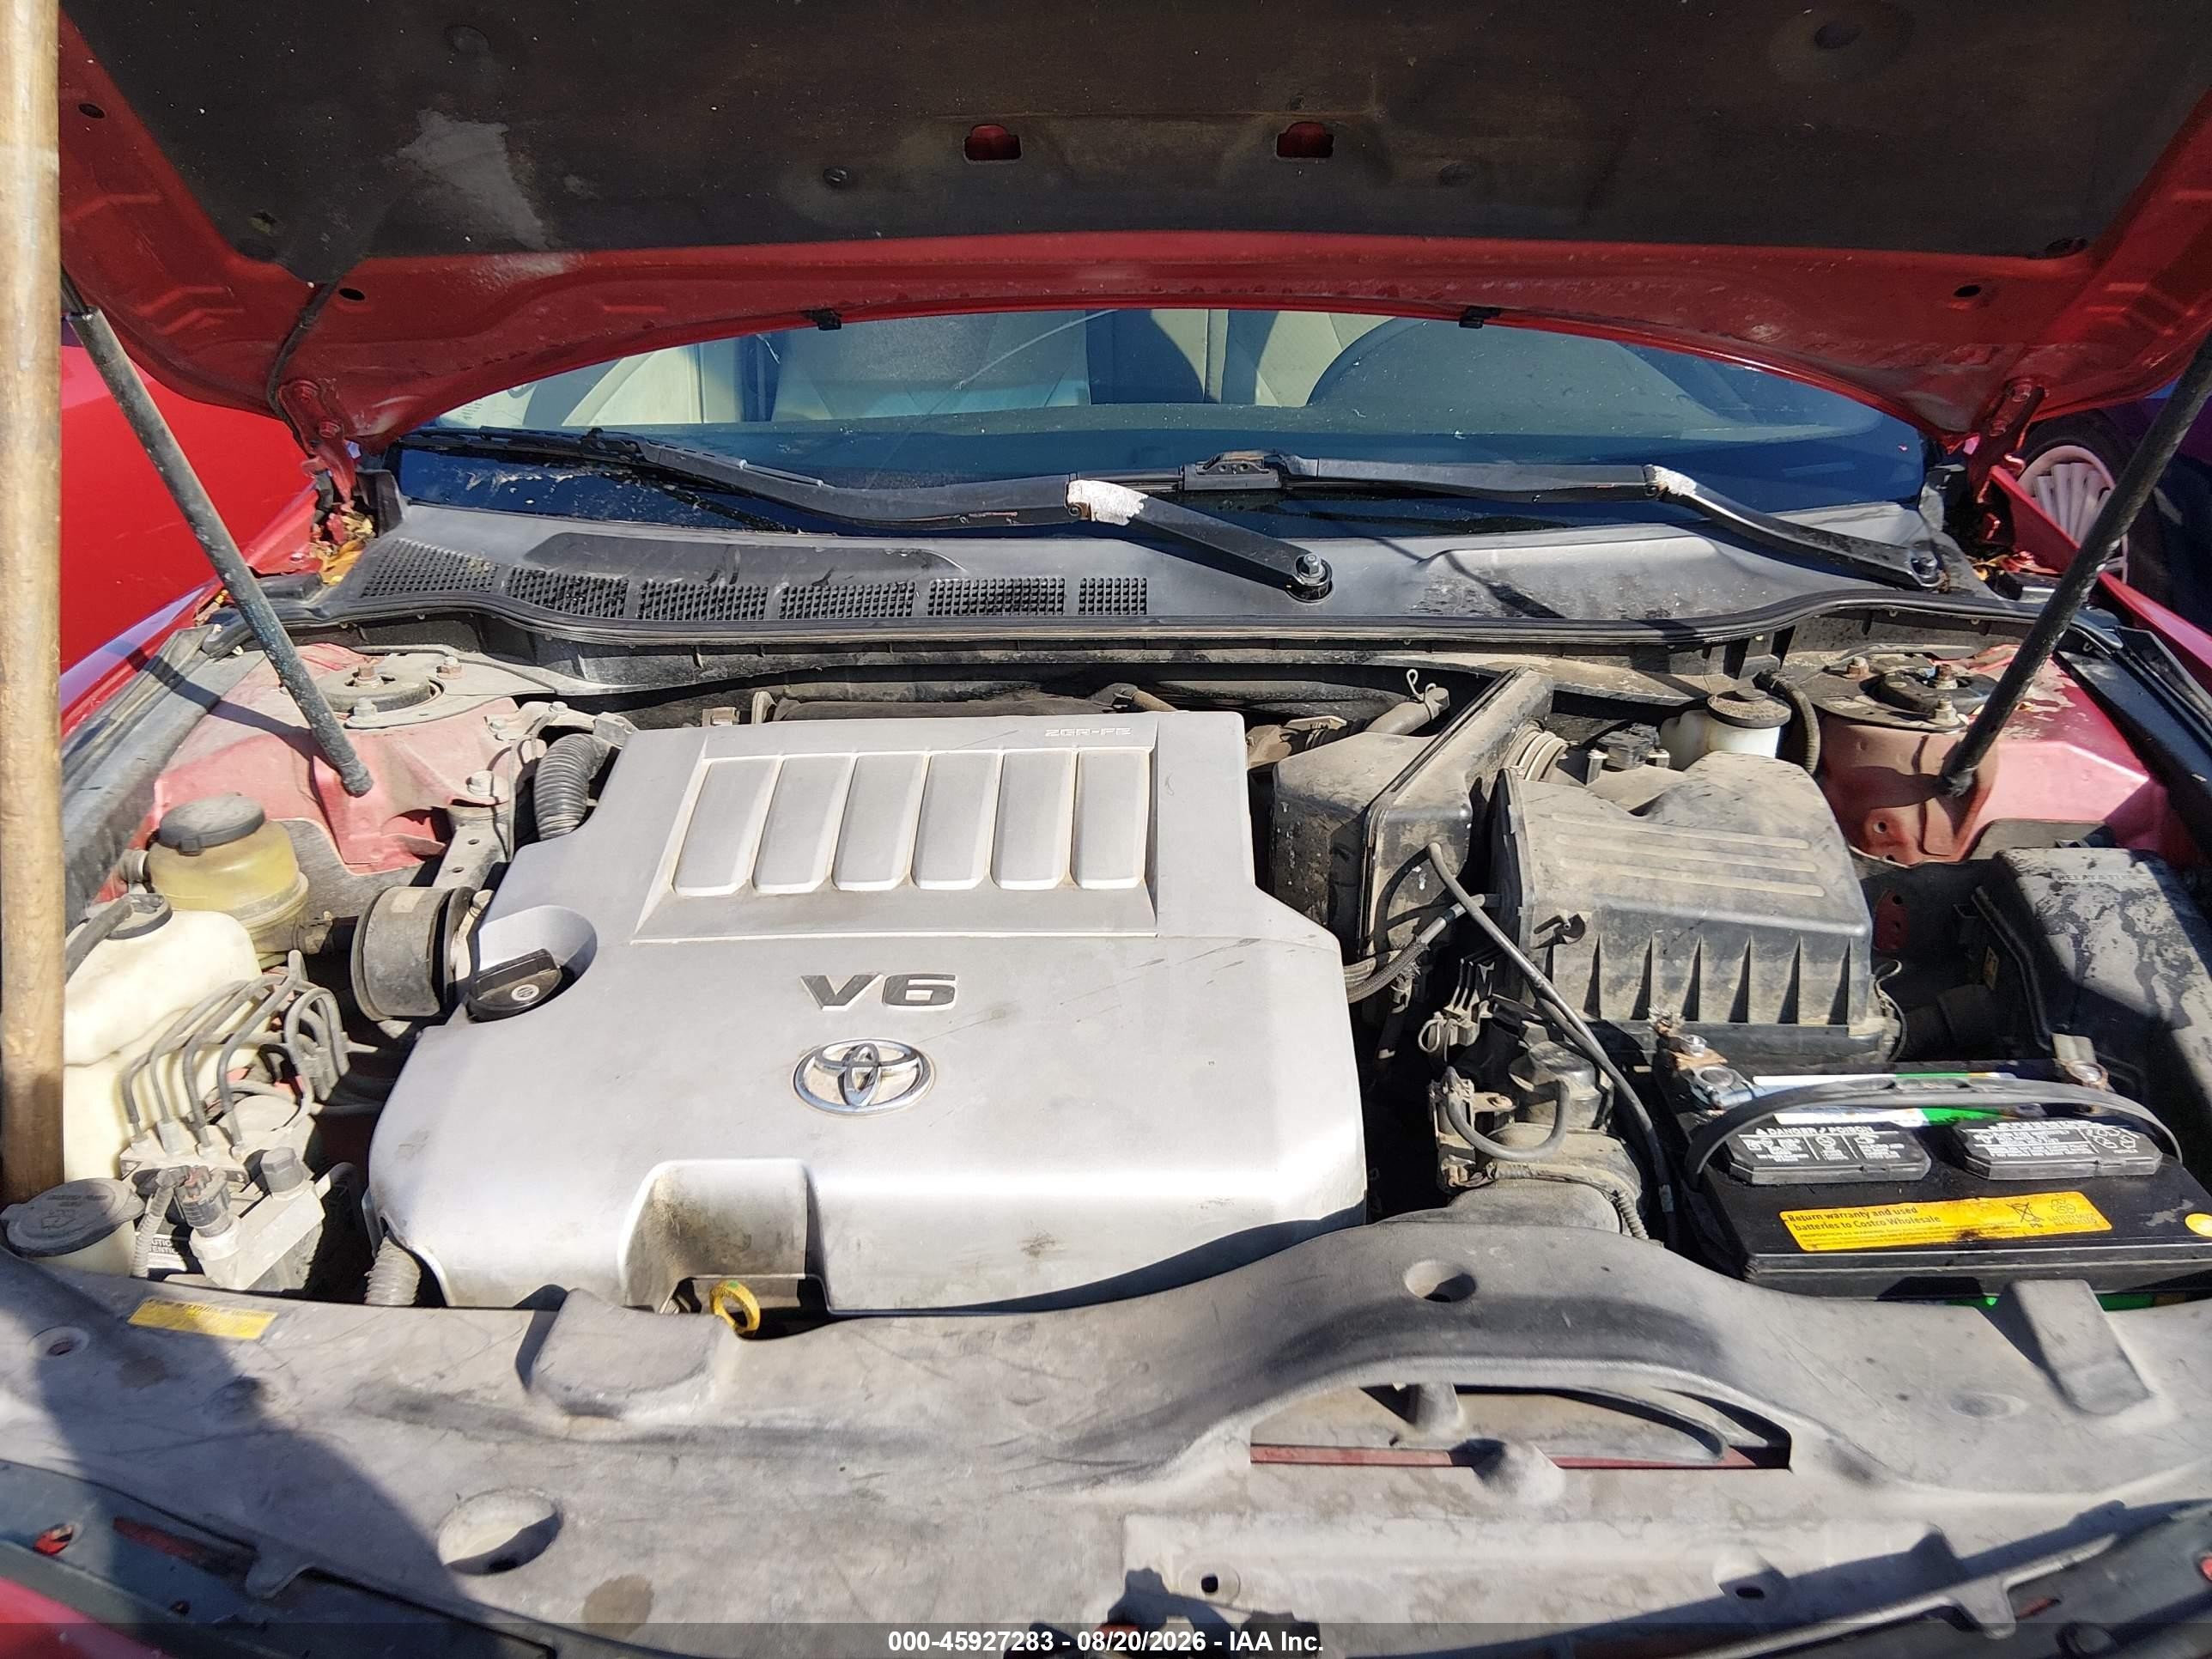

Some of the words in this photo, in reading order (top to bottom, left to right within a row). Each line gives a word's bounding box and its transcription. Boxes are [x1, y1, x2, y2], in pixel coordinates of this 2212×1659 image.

[800, 973, 957, 1011] V6
[1766, 1127, 1818, 1135] DANGER
[1788, 1213, 1822, 1223] Return
[1824, 1210, 1870, 1220] warranty
[1871, 1208, 1893, 1217] and
[1893, 1206, 1917, 1215] used
[1794, 1221, 1840, 1231] batteries
[1854, 1219, 1887, 1228] Costco
[1888, 1215, 1942, 1226] Wholesale
